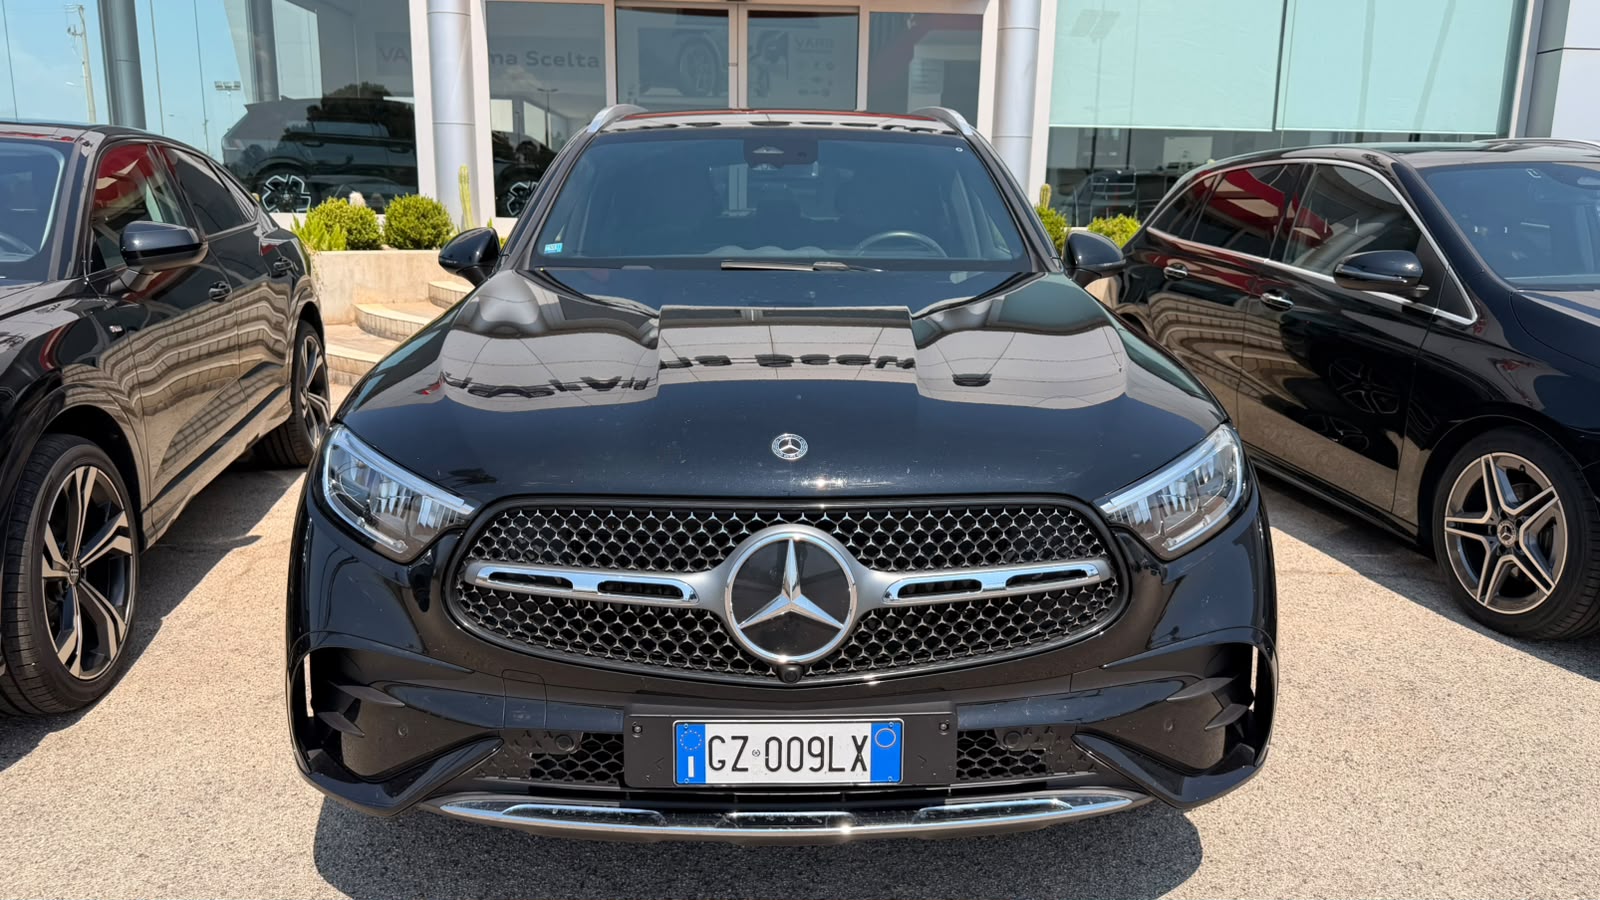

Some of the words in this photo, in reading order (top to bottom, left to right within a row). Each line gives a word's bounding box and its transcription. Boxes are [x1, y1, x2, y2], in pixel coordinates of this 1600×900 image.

[378, 47, 409, 63] VA
[489, 53, 518, 66] ma
[526, 50, 600, 69] Scelta
[687, 755, 695, 778] I
